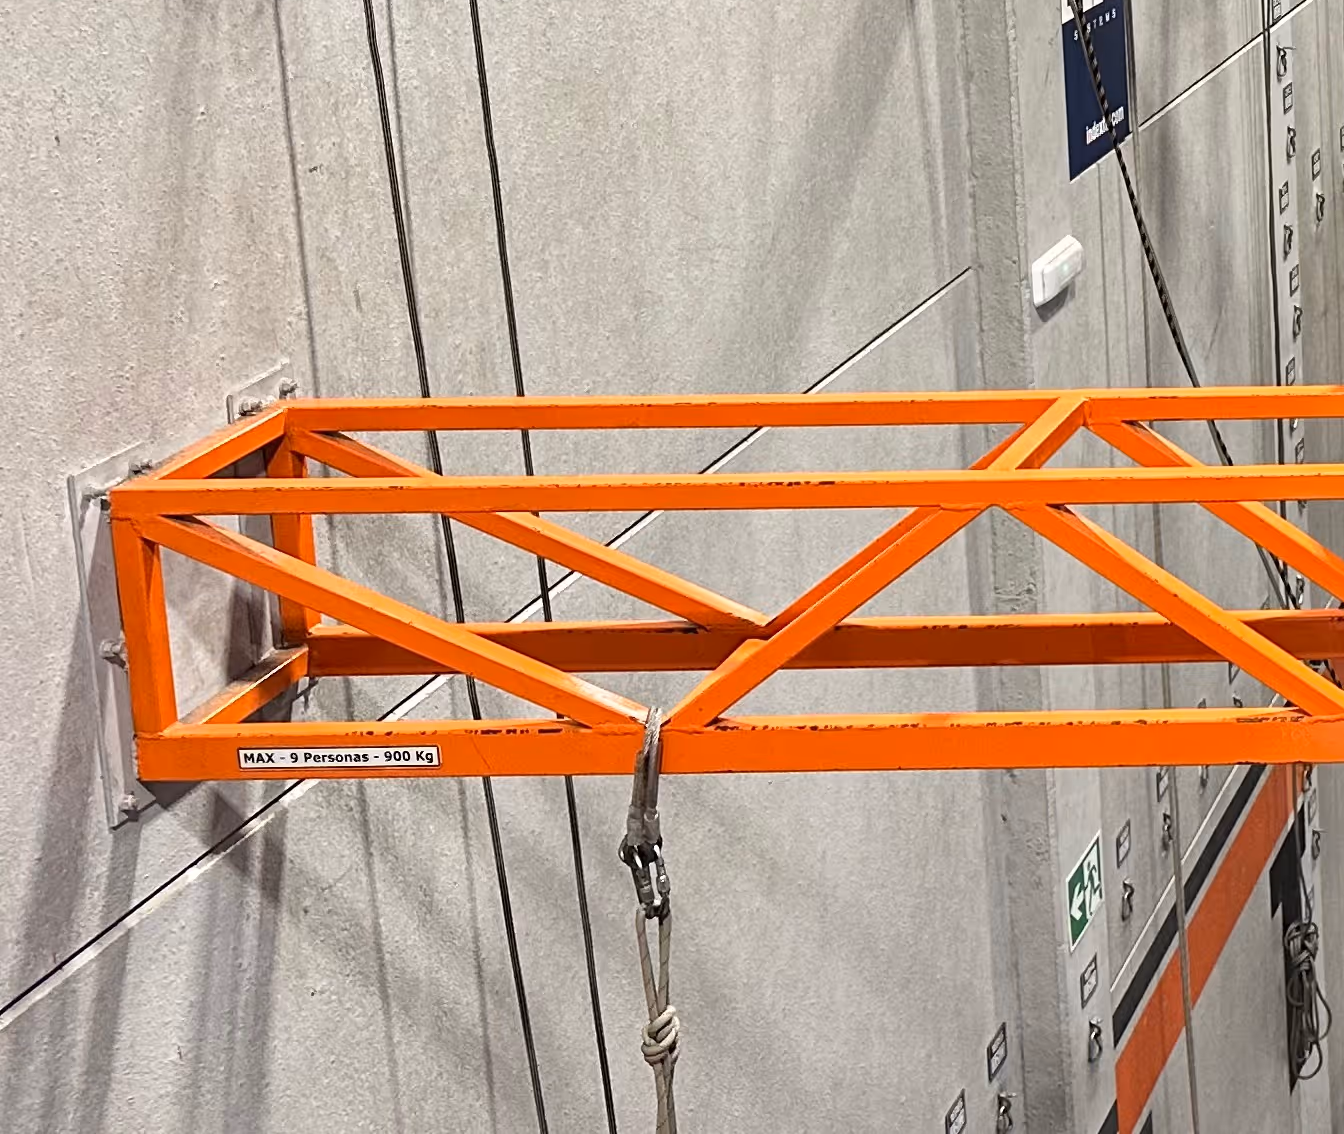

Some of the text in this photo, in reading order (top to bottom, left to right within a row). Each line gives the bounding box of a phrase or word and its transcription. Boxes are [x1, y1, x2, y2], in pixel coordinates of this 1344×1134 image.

[1073, 8, 1117, 42] SSTEMS
[244, 752, 275, 764] MAX
[290, 752, 299, 764] 9
[304, 752, 369, 763] Personas
[384, 750, 411, 762] 900
[416, 750, 434, 764] Kg
